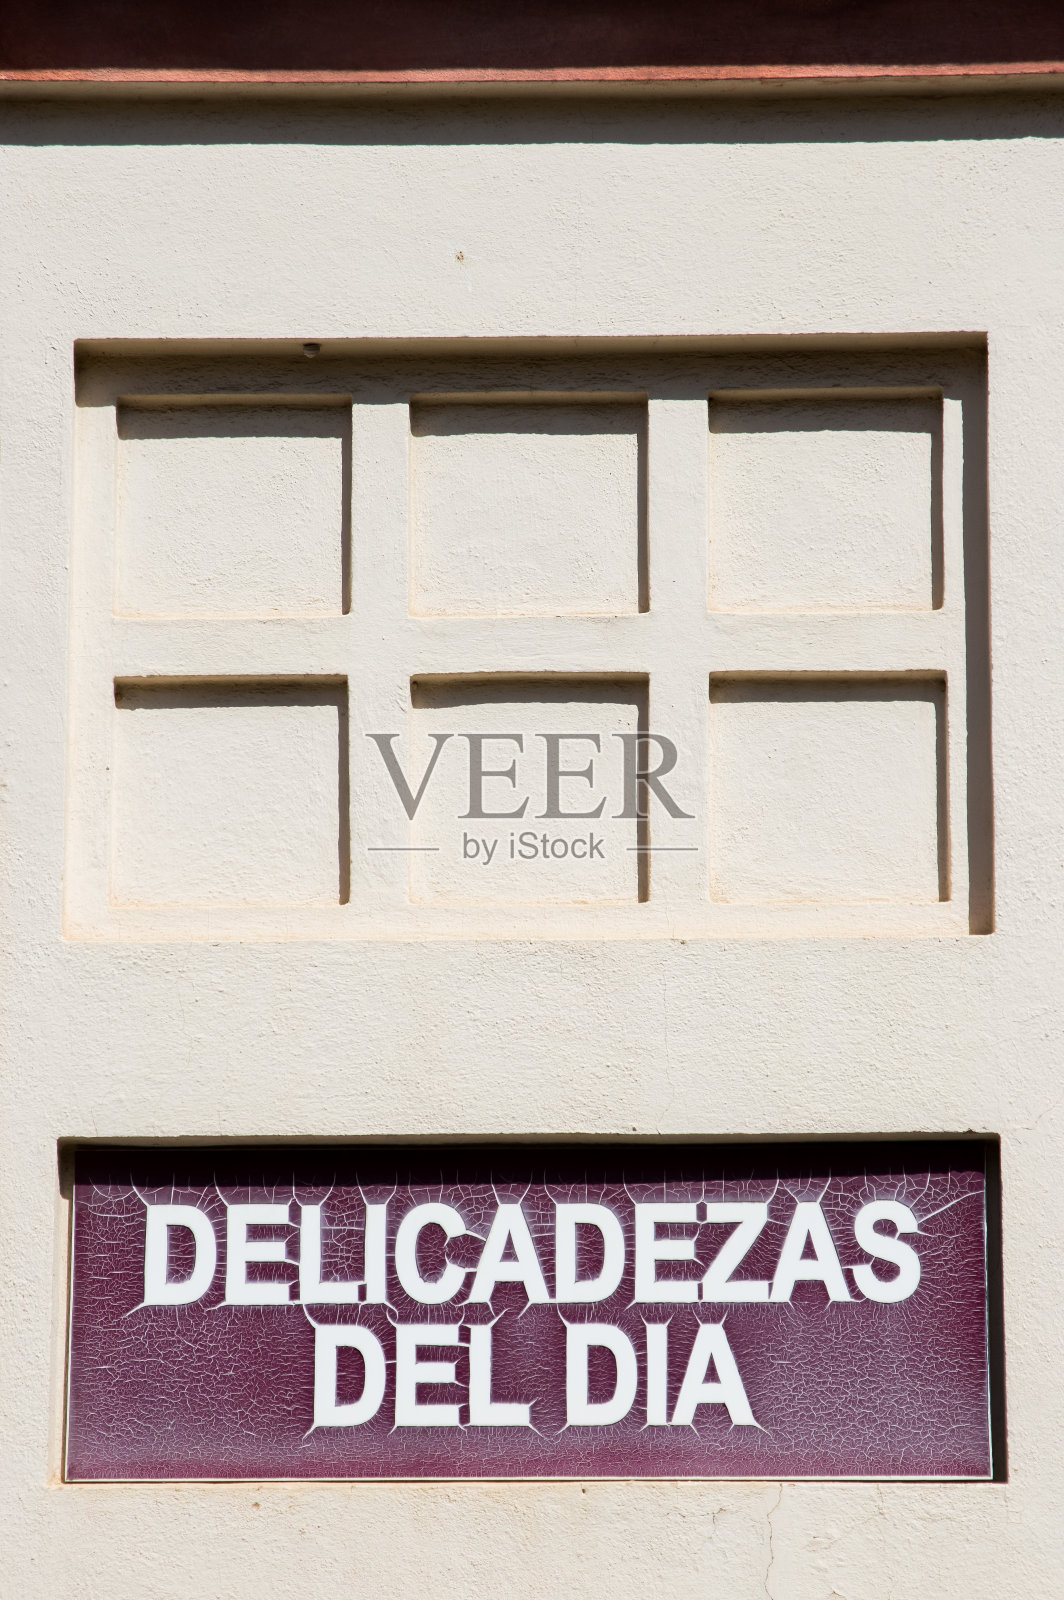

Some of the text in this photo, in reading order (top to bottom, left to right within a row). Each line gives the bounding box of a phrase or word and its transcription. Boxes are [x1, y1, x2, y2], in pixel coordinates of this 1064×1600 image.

[143, 1199, 923, 1307] DELICADEZAS
[313, 1321, 756, 1427] DEL DIA
